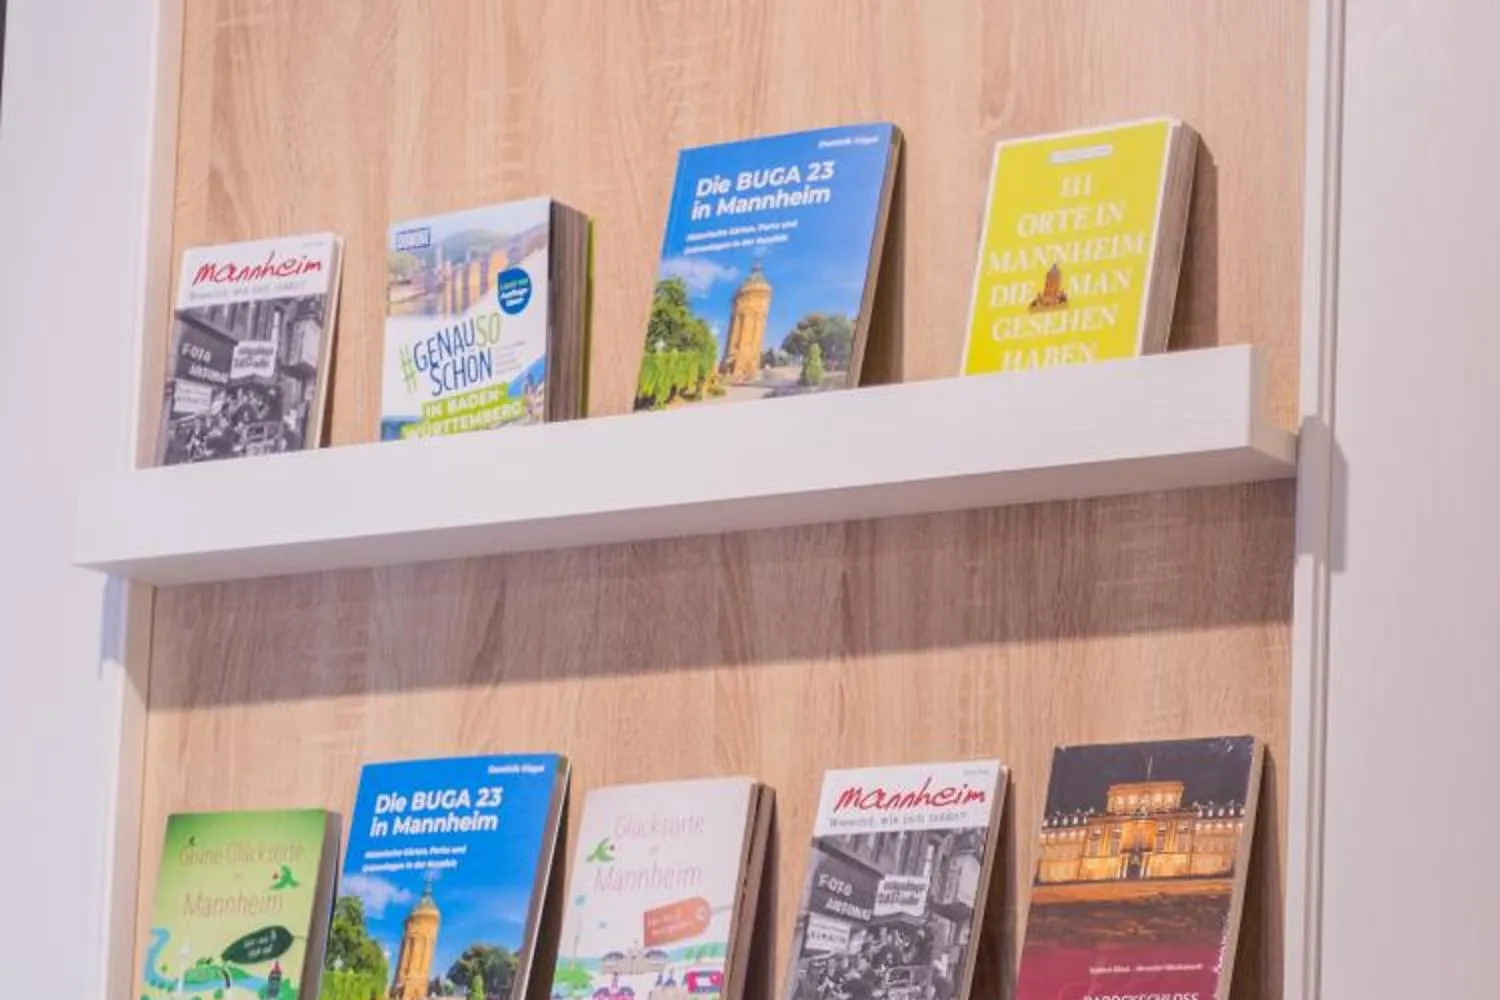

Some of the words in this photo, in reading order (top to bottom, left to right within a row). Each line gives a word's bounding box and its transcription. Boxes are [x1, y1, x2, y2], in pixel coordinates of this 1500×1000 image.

[696, 174, 732, 197] Die
[736, 165, 800, 191] BUGA
[806, 161, 835, 182] 23
[691, 201, 711, 221] in
[716, 185, 831, 216] Mannheim
[1016, 206, 1090, 238] ORTE
[1095, 200, 1126, 227] IN
[987, 234, 1146, 274] MANNHEIM
[991, 281, 1036, 308] DIE
[1069, 267, 1134, 297] MAN
[992, 304, 1119, 341] GESEHEN
[375, 792, 406, 814] Die
[411, 789, 471, 811] BUGA
[476, 786, 503, 808] 23
[370, 817, 387, 837] in
[393, 811, 498, 836] Mannheim
[594, 860, 703, 893] Mannheim
[184, 889, 283, 918] Mannheim
